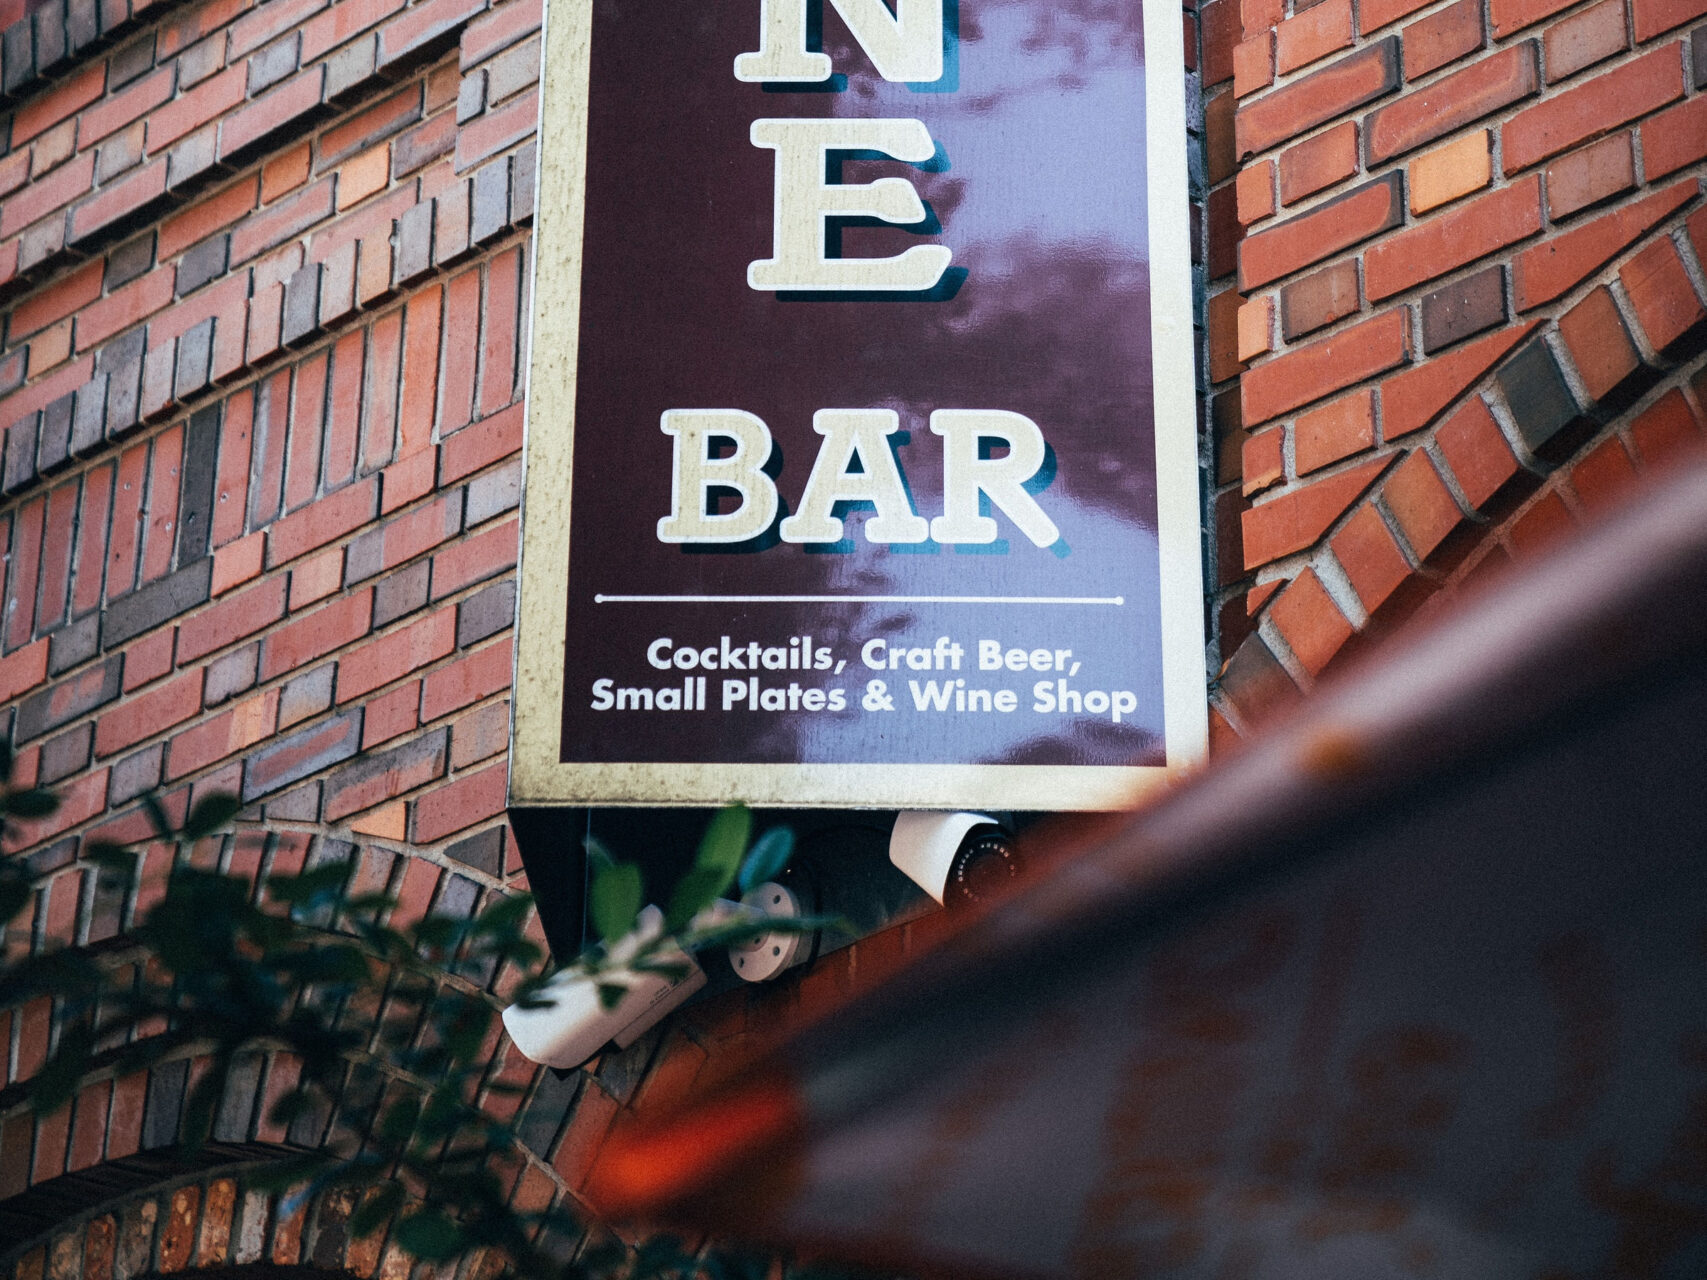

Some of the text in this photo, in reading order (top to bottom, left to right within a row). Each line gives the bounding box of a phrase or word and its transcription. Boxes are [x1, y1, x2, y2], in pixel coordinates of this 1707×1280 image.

[656, 408, 1060, 548] BAR
[646, 636, 1082, 677] Cocktails, Craft Beer,
[590, 677, 1138, 723] Small Plates & Wine Shop
